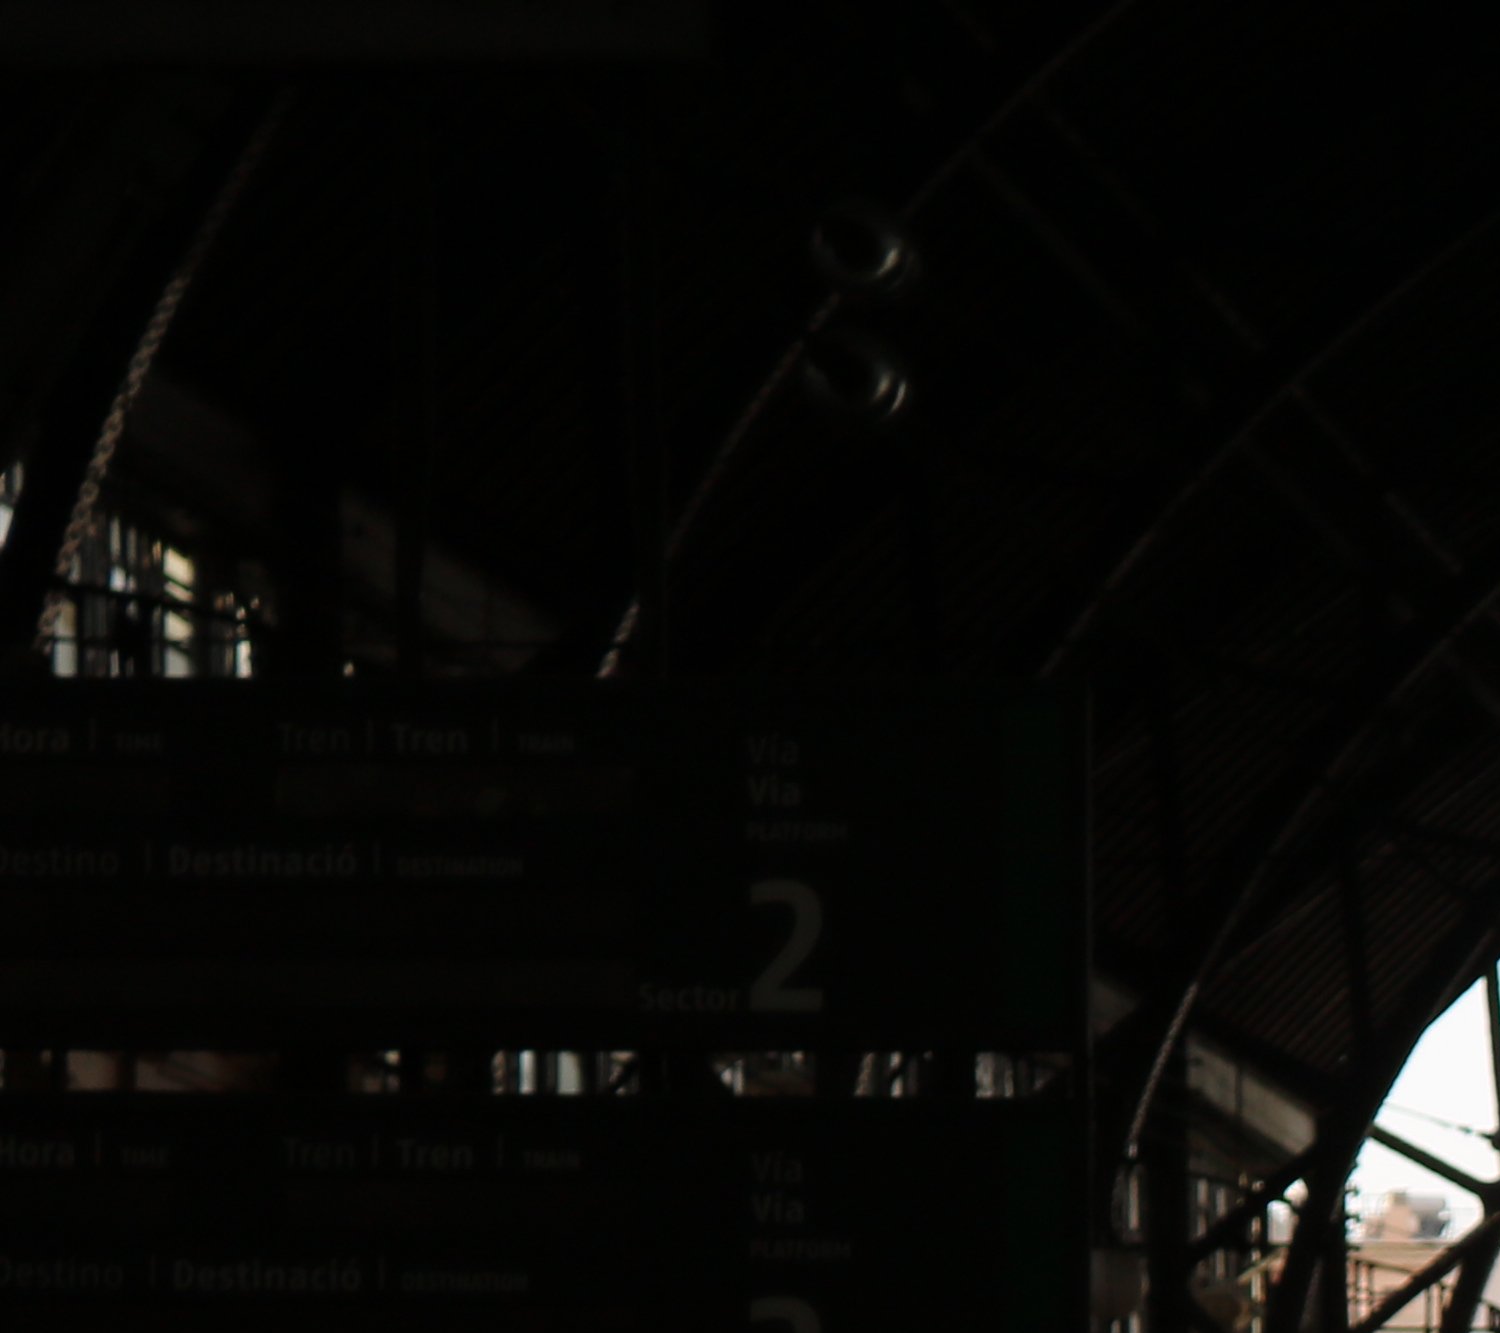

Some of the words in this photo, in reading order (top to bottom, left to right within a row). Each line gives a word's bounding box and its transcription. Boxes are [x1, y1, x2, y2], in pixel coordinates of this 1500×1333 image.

[276, 722, 351, 754] Tren
[389, 722, 470, 754] Tren
[168, 841, 358, 879] Destinació
[749, 879, 823, 1012] 2
[639, 982, 740, 1012] Sector
[283, 1136, 357, 1169] Tren
[396, 1136, 475, 1170] Tren
[172, 1256, 363, 1293] Destinació
